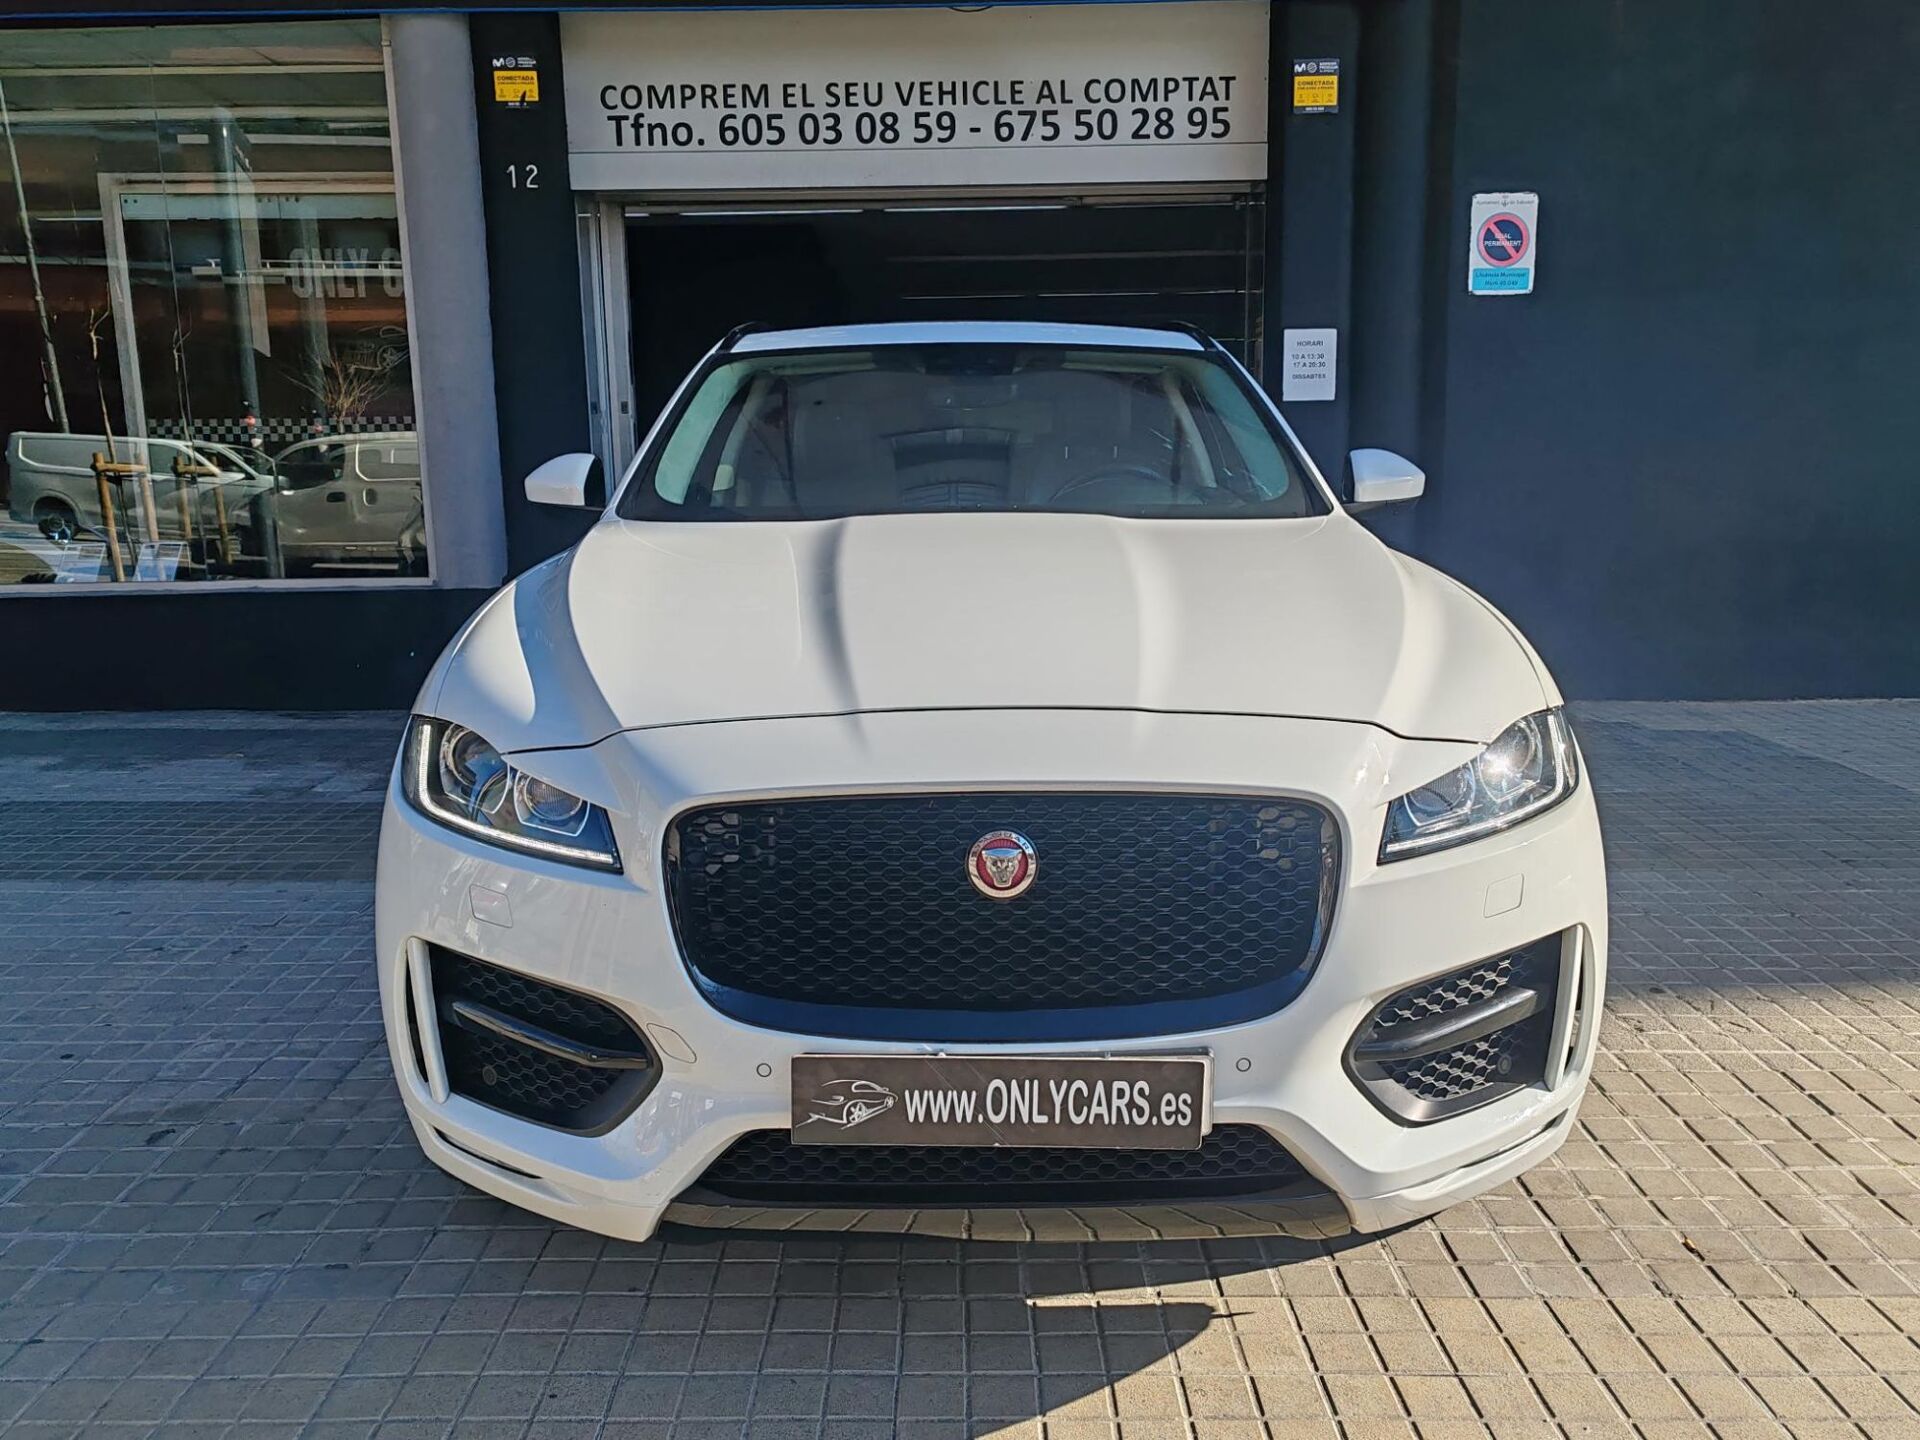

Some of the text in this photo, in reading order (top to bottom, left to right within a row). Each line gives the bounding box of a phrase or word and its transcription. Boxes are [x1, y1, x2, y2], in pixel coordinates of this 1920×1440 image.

[600, 76, 1237, 110] COMPREM EL SEU VEHICLE AL COMPTAT
[606, 112, 706, 147] Tfno.
[718, 112, 786, 147] 605
[798, 111, 842, 145] 03
[855, 111, 901, 145] 08
[913, 110, 956, 144] 59
[994, 109, 1061, 143] 675
[1074, 108, 1119, 142] 50
[1130, 107, 1175, 141] 28
[1186, 106, 1232, 140] 95
[506, 164, 539, 189] 12
[289, 247, 369, 298] ONLY
[903, 1077, 1193, 1127] www.ONLYCARS.es
